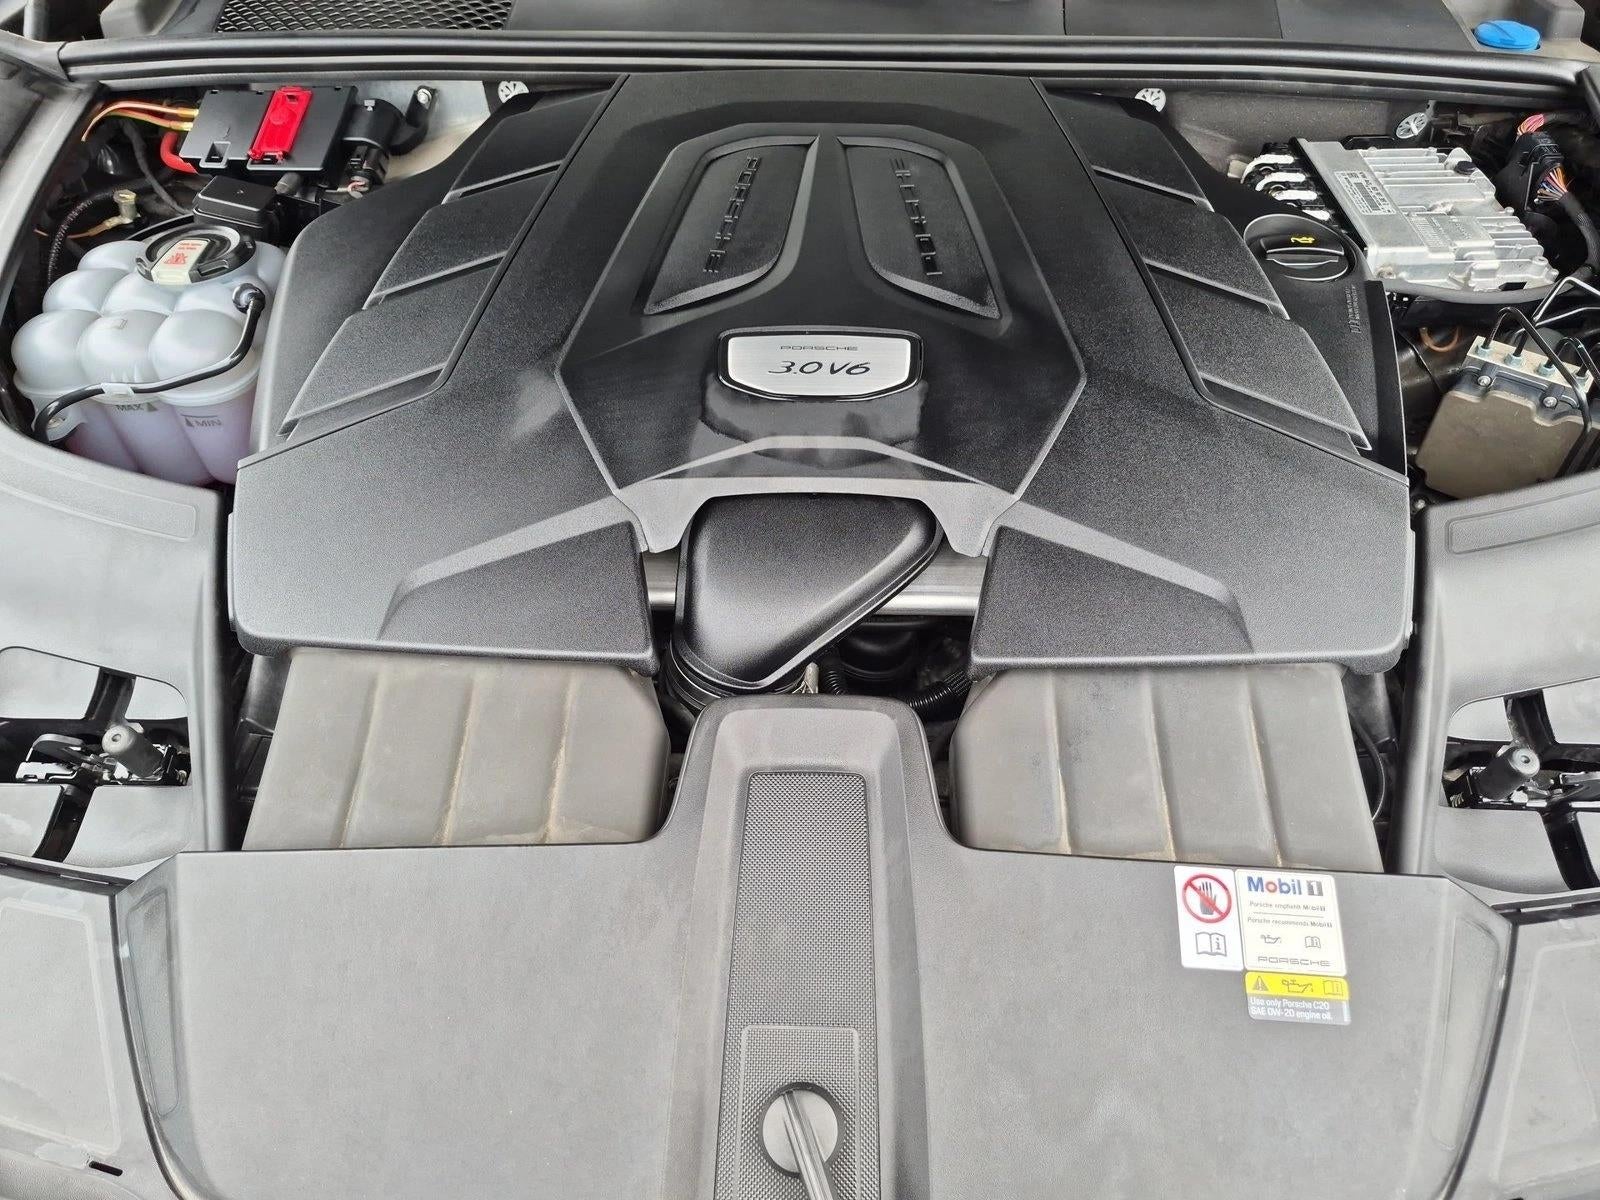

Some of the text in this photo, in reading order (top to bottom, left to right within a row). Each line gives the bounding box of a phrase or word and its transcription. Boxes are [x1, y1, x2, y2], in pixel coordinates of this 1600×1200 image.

[780, 344, 859, 352] PORSCHE
[115, 404, 144, 412] MAX
[194, 418, 222, 427] MIN
[1246, 876, 1302, 895] Mobil
[1257, 955, 1331, 967] PORSCHE
[1249, 997, 1330, 1011] Use only Porsche C20
[1250, 1006, 1267, 1016] SAE
[1296, 1009, 1321, 1020] engine
